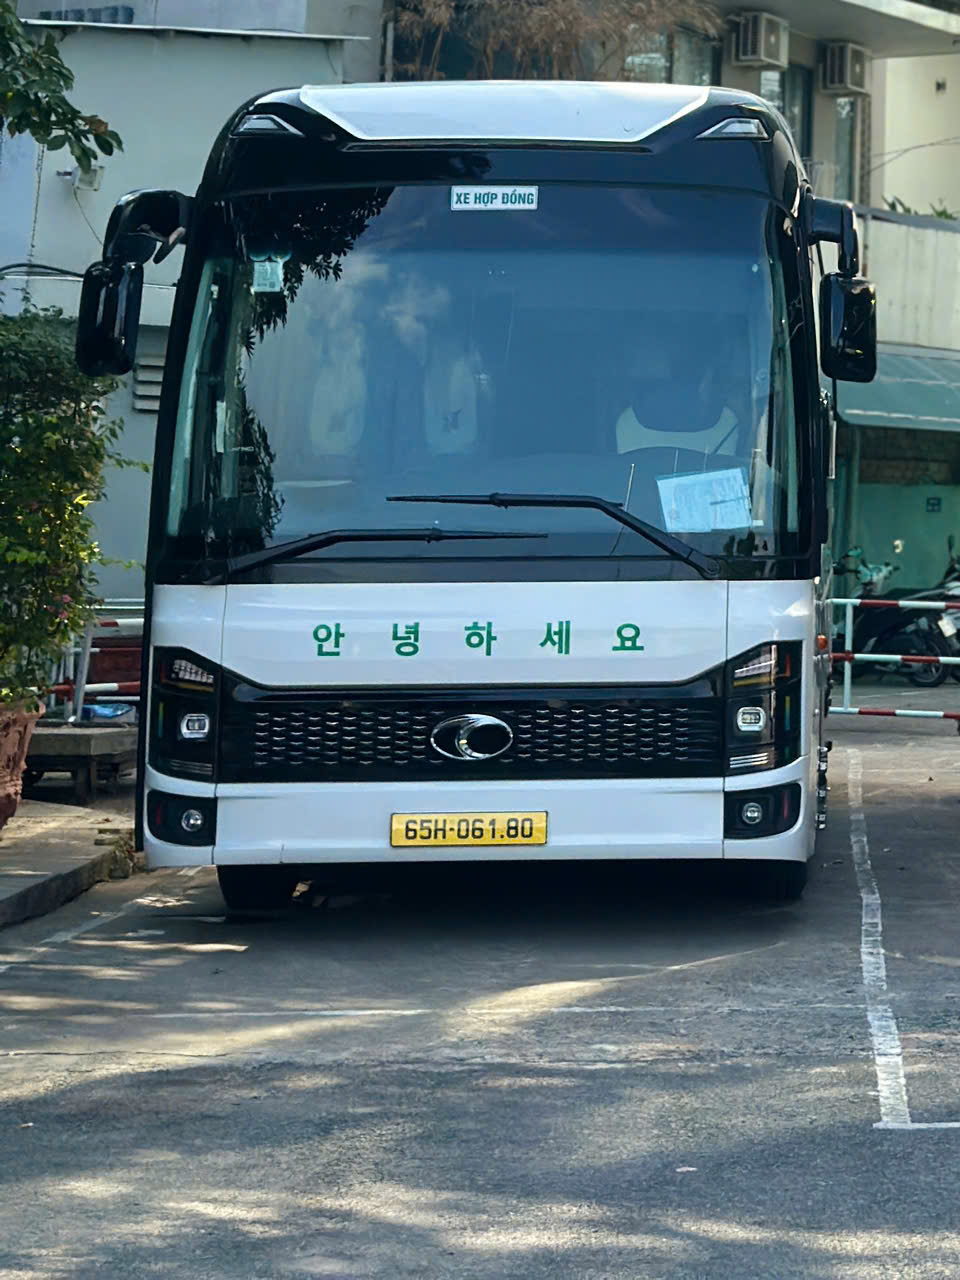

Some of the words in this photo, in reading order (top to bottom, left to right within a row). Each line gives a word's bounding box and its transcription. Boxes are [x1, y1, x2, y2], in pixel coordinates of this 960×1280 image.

[455, 193, 470, 204] XE
[474, 191, 498, 207] HỢP
[405, 818, 534, 840] 65H-061.80
